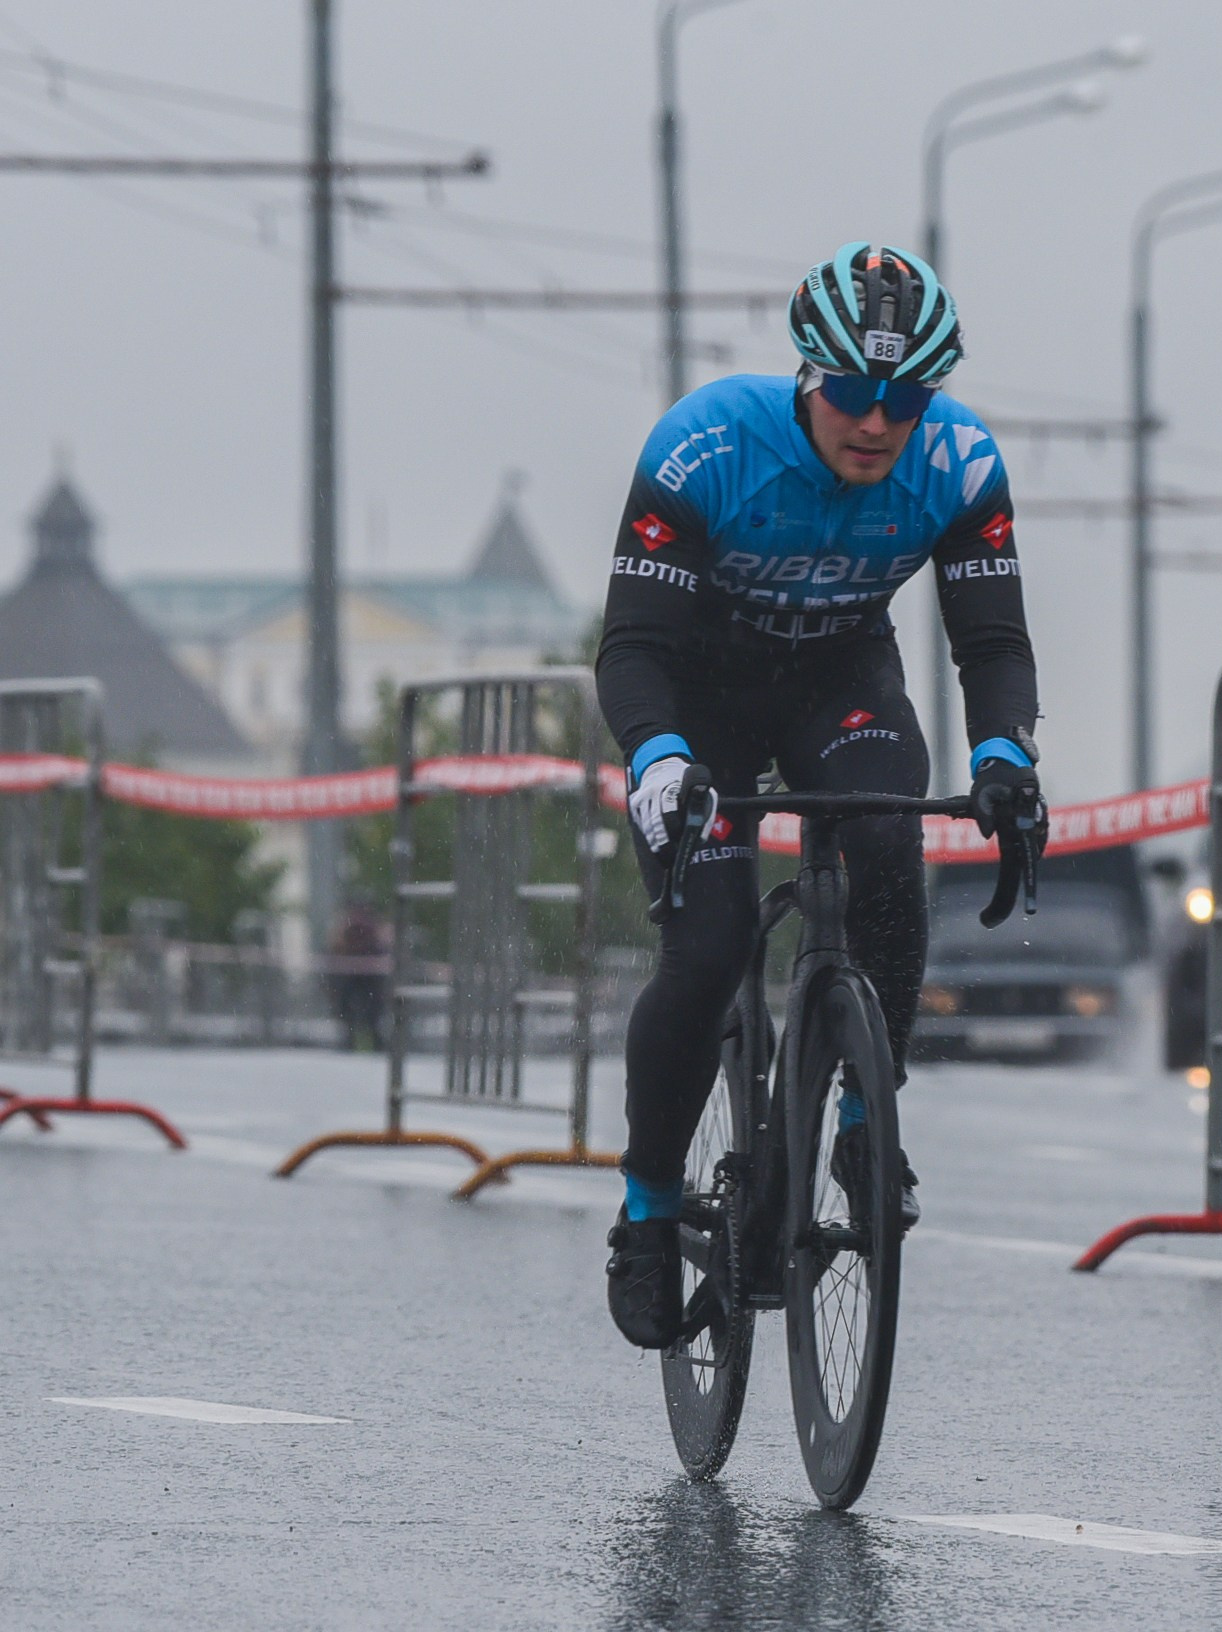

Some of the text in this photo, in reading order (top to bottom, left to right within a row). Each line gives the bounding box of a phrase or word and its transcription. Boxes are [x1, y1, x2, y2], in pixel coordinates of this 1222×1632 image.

[874, 341, 896, 358] 88
[612, 556, 699, 593] ELDTITE
[715, 550, 923, 584] RIBBLE
[820, 729, 900, 759] WELDTITE
